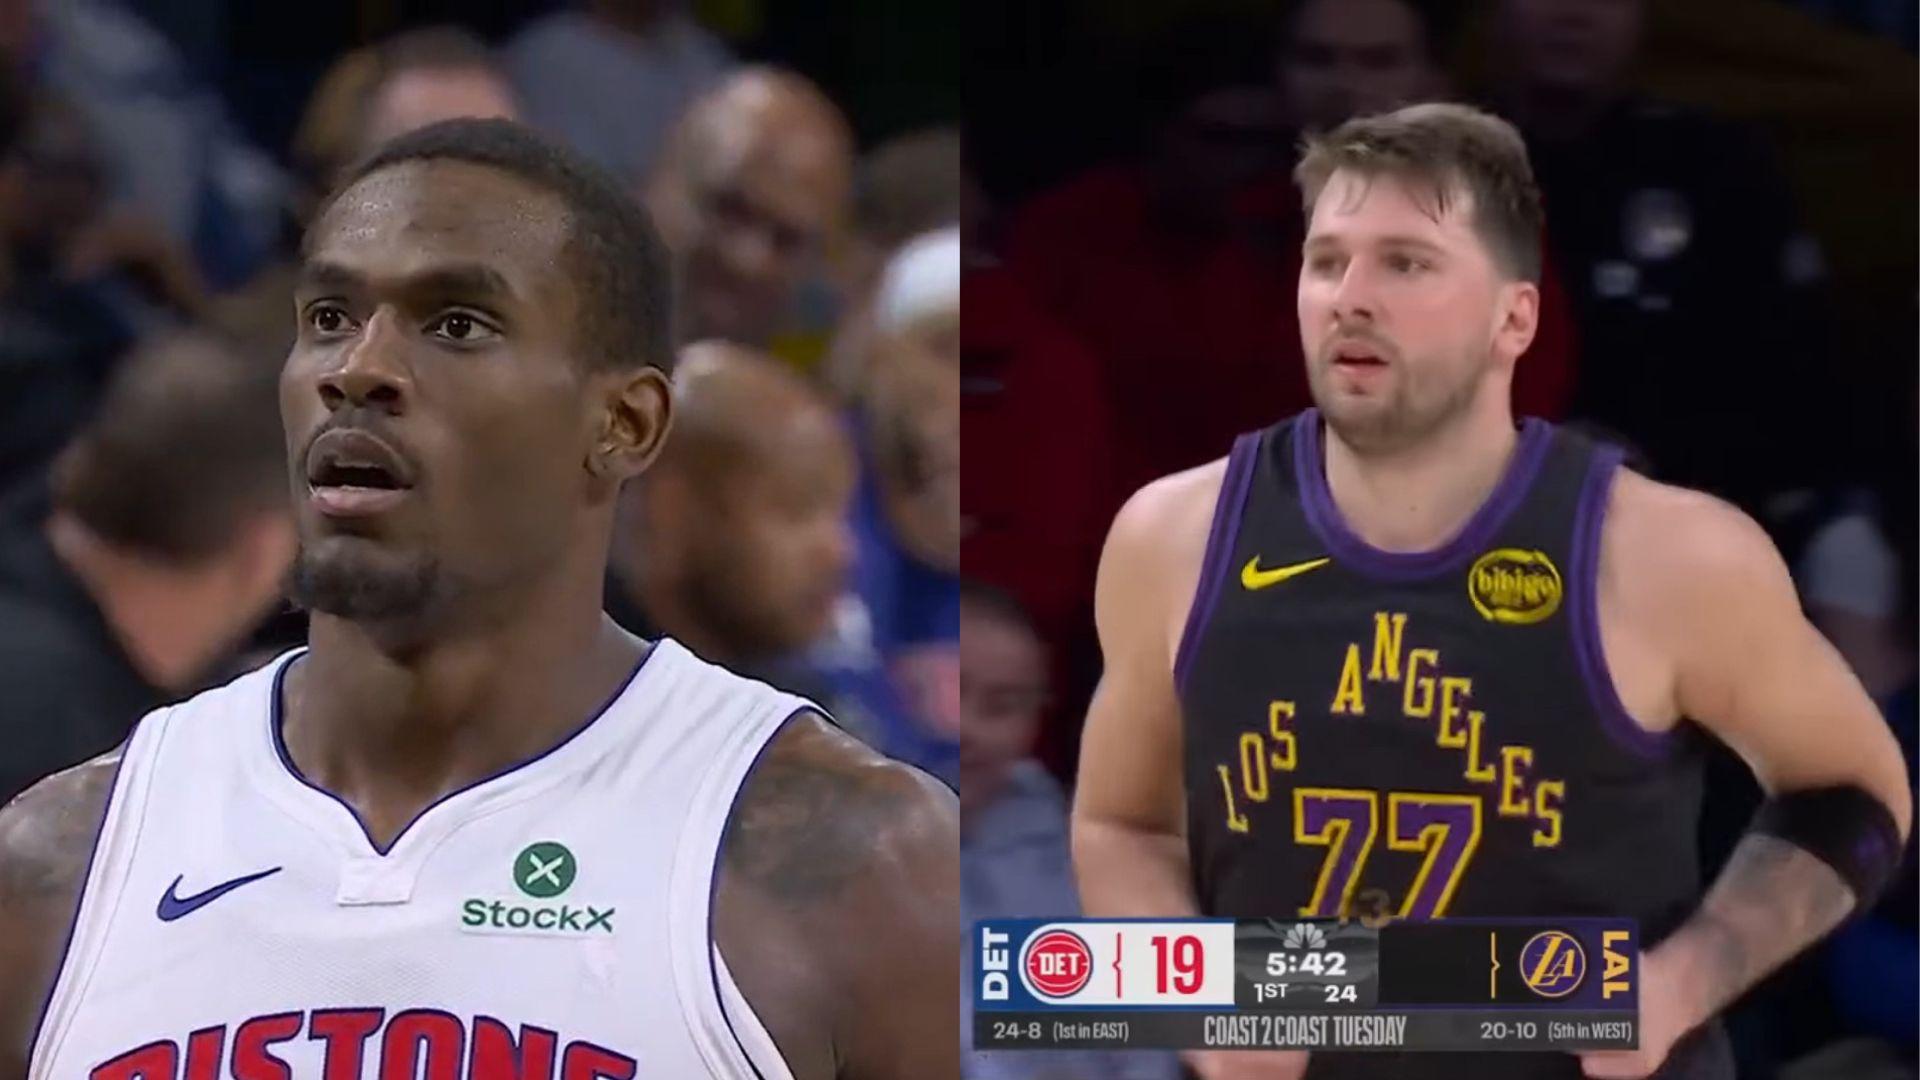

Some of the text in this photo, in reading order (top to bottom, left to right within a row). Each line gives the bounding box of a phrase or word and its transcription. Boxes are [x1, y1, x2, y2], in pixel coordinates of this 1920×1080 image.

[1217, 611, 1565, 848] LOS ANGELES
[461, 899, 616, 933] StockX
[1293, 787, 1482, 918] 77
